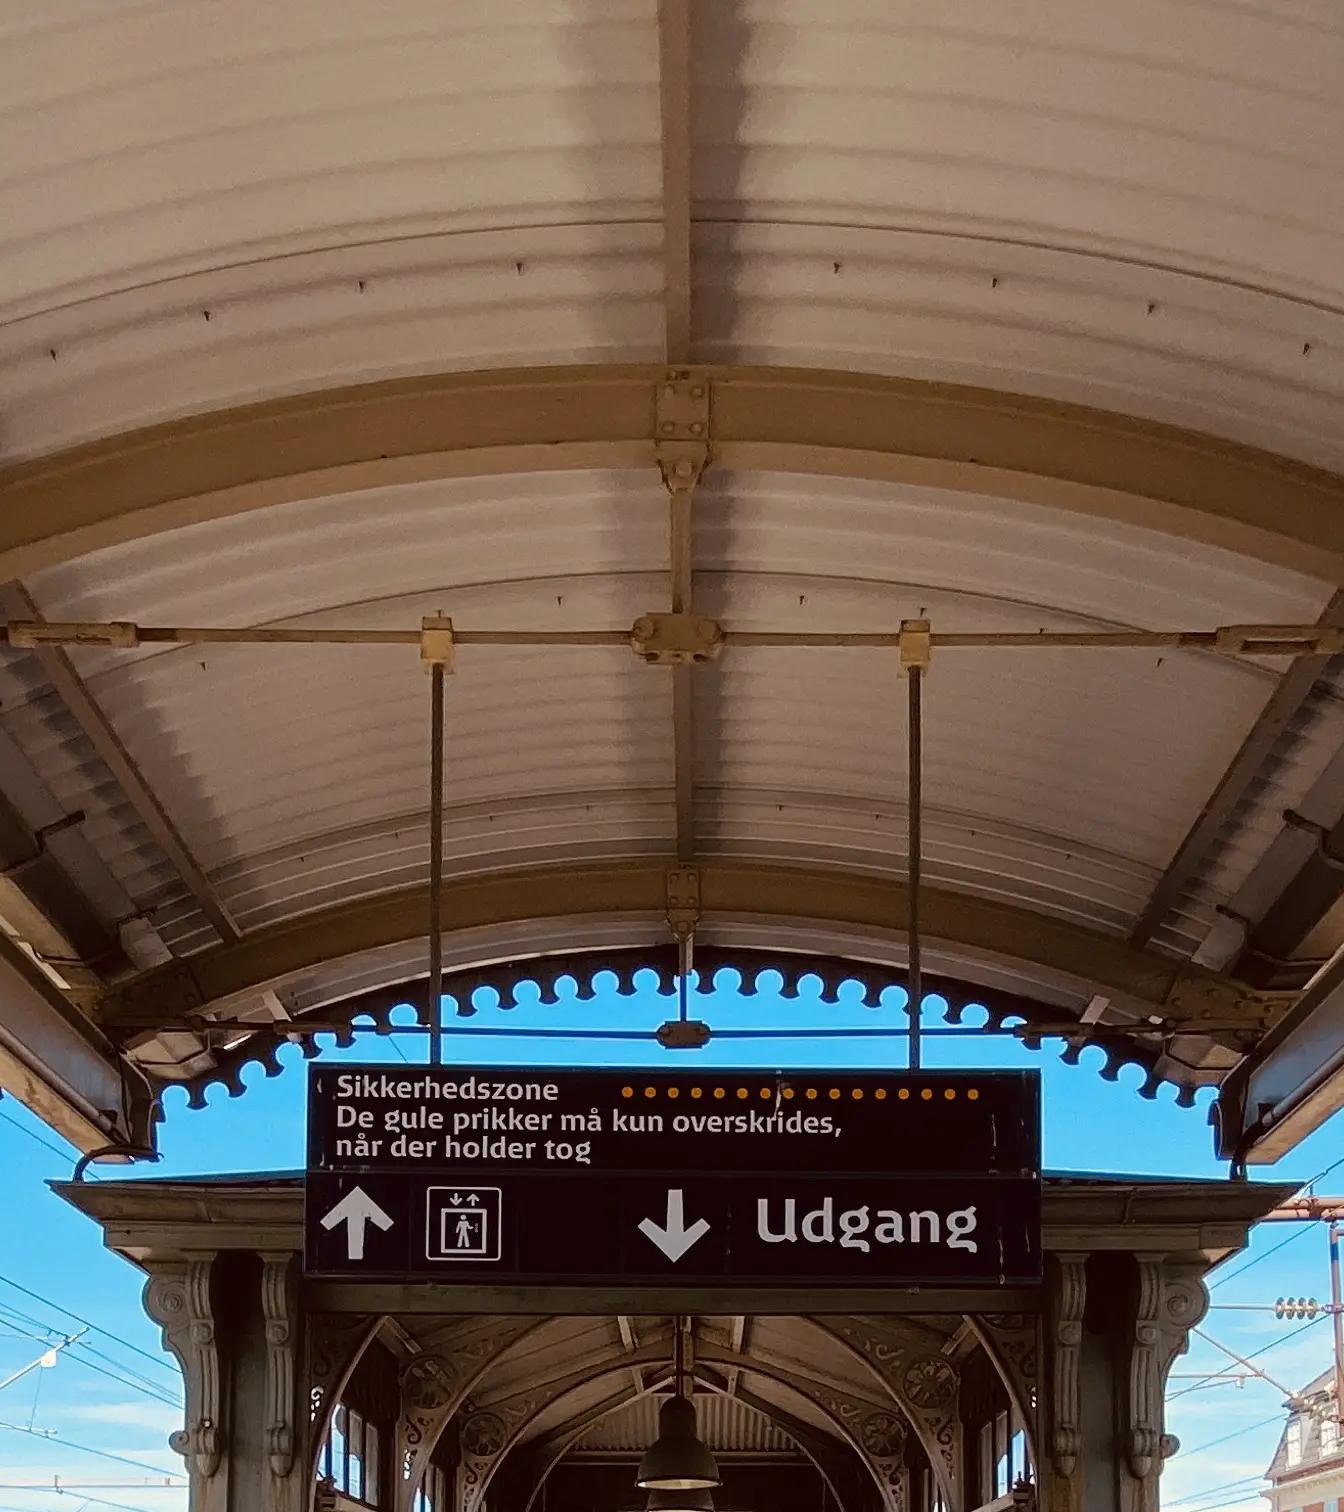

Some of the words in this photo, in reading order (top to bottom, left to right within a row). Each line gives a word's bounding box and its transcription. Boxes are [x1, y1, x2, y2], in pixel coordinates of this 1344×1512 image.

[337, 1075, 559, 1101] Sikkerhedszone
[337, 1105, 374, 1129] De
[384, 1106, 444, 1133] gule
[453, 1107, 552, 1135] prikker
[560, 1107, 602, 1132] må
[613, 1108, 663, 1132] kun
[672, 1110, 842, 1138] overskrides,
[336, 1133, 383, 1157] når
[391, 1135, 437, 1158] der
[445, 1135, 536, 1159] holder
[544, 1139, 591, 1164] tog
[757, 1196, 978, 1254] Udgang
